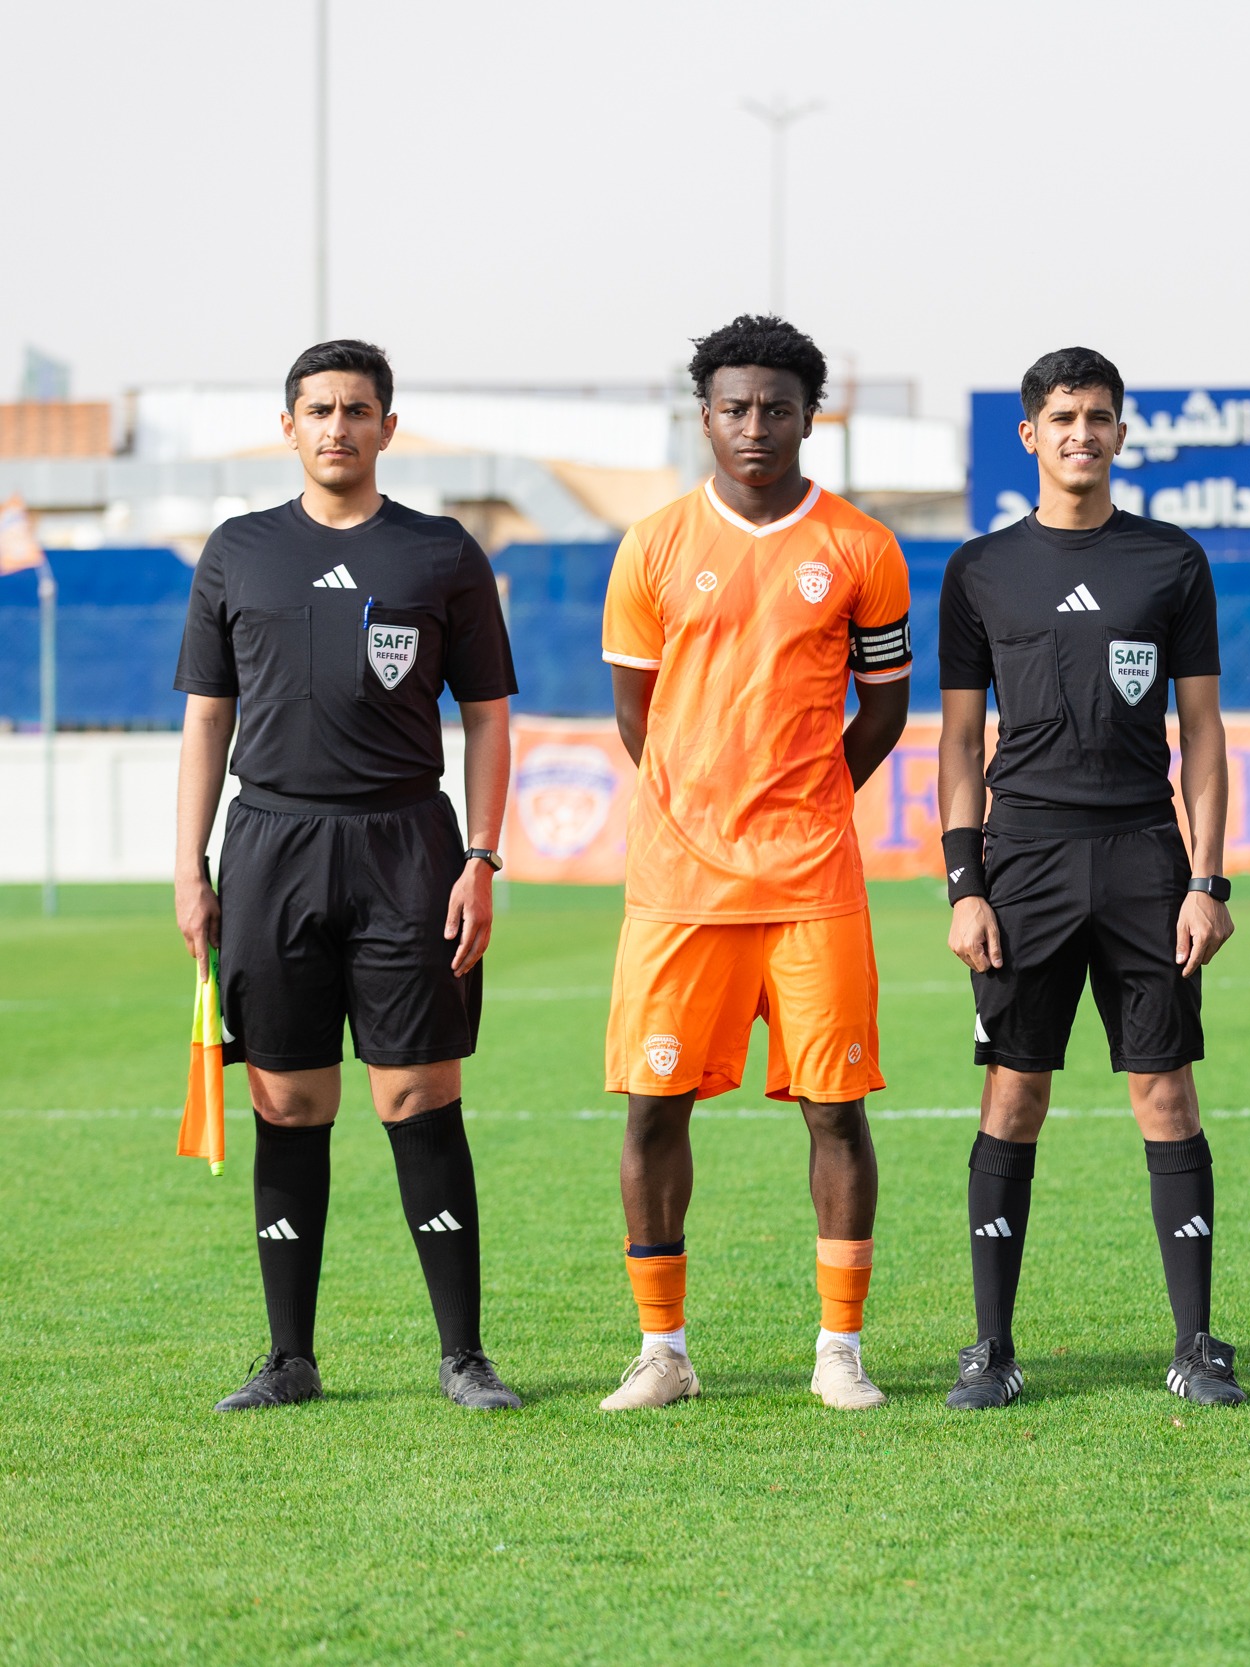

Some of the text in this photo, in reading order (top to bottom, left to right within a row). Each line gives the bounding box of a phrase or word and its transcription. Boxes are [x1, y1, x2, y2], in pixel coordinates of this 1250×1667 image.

[373, 632, 414, 650] SAFF
[376, 651, 409, 662] REFEREE
[1114, 649, 1154, 666] SAFF
[1118, 668, 1150, 677] REFEREE
